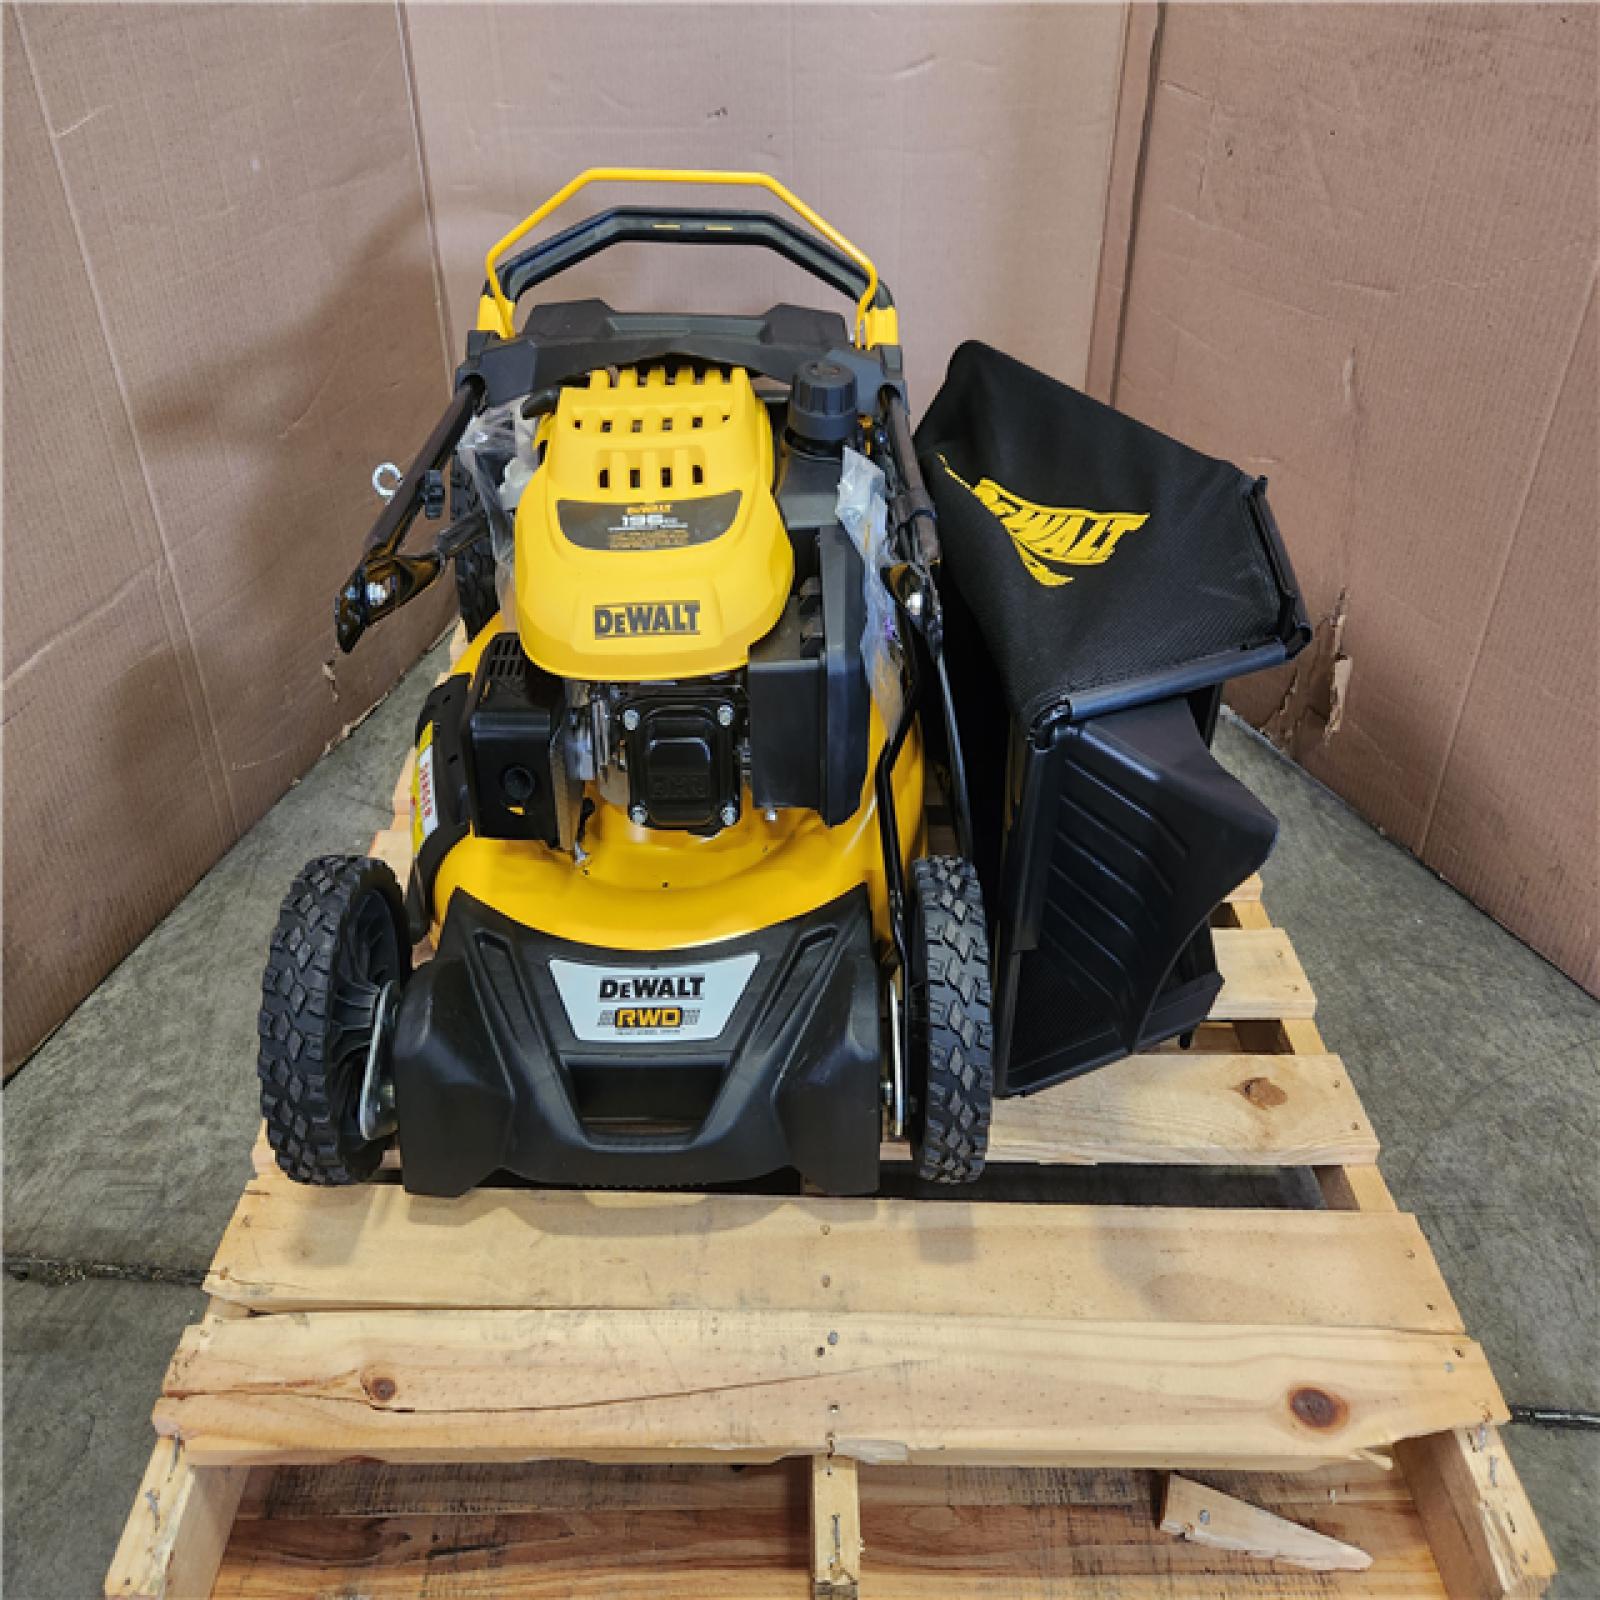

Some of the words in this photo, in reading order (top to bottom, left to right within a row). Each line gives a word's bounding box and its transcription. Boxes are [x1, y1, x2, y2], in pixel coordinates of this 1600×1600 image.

[976, 484, 1150, 562] WALT
[600, 976, 705, 998] DEWALT
[618, 1008, 680, 1026] RWD
